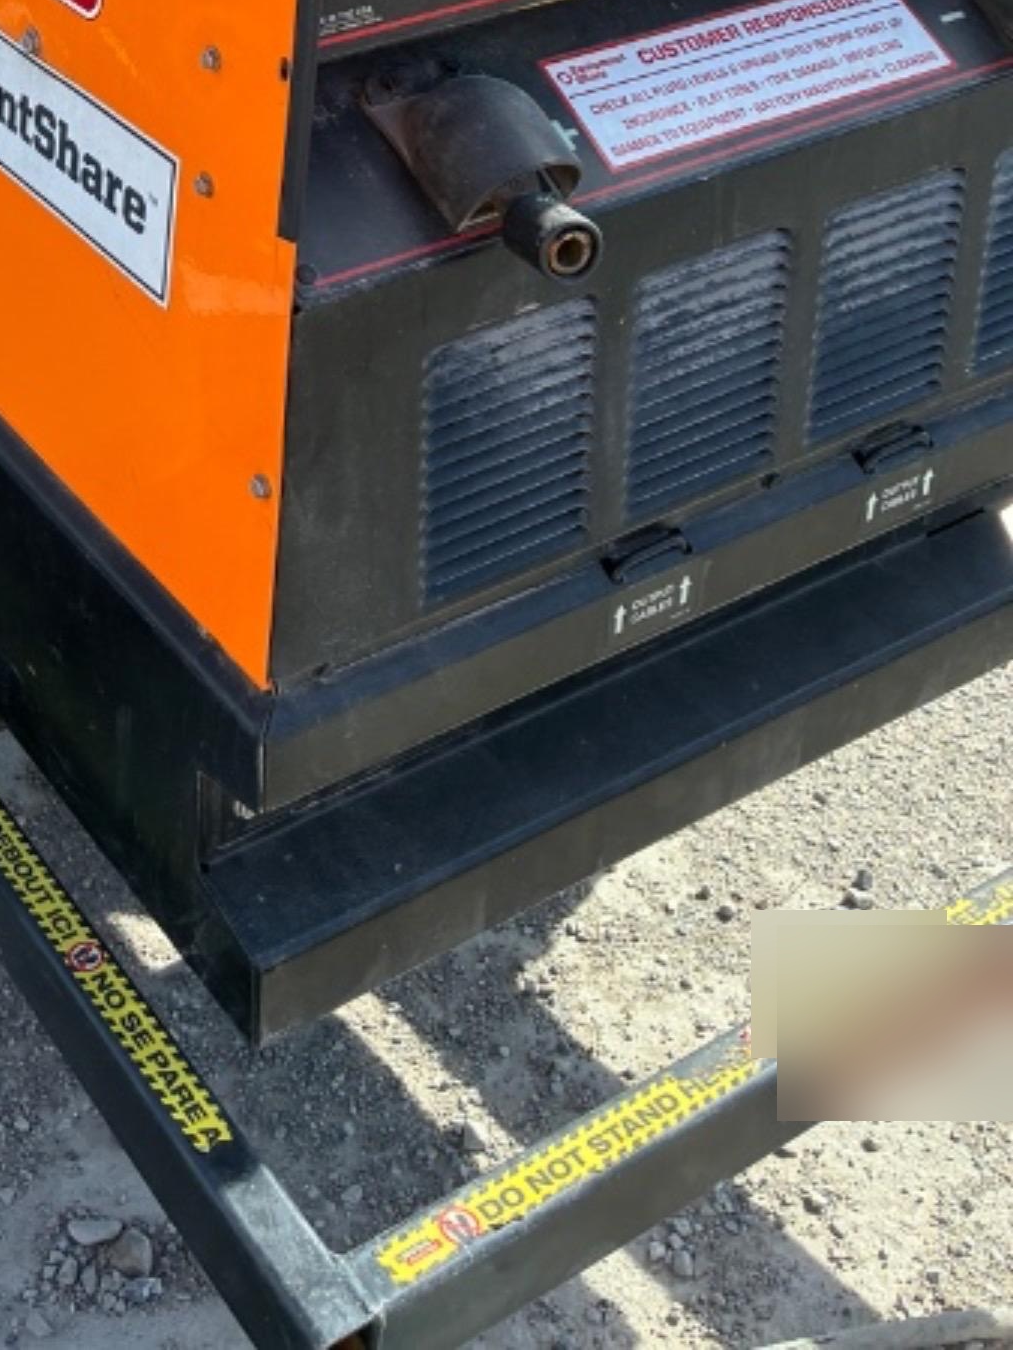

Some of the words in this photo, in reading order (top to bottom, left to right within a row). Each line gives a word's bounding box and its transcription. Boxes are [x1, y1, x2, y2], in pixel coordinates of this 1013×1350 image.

[637, 24, 740, 64] CUSTOMER
[46, 907, 78, 941] ICI
[90, 971, 126, 1009] NO
[120, 1011, 156, 1049] SE
[145, 1049, 209, 1125] PARE
[477, 1186, 526, 1223] DO
[525, 1148, 590, 1194] NOT
[588, 1092, 680, 1156] STAND
